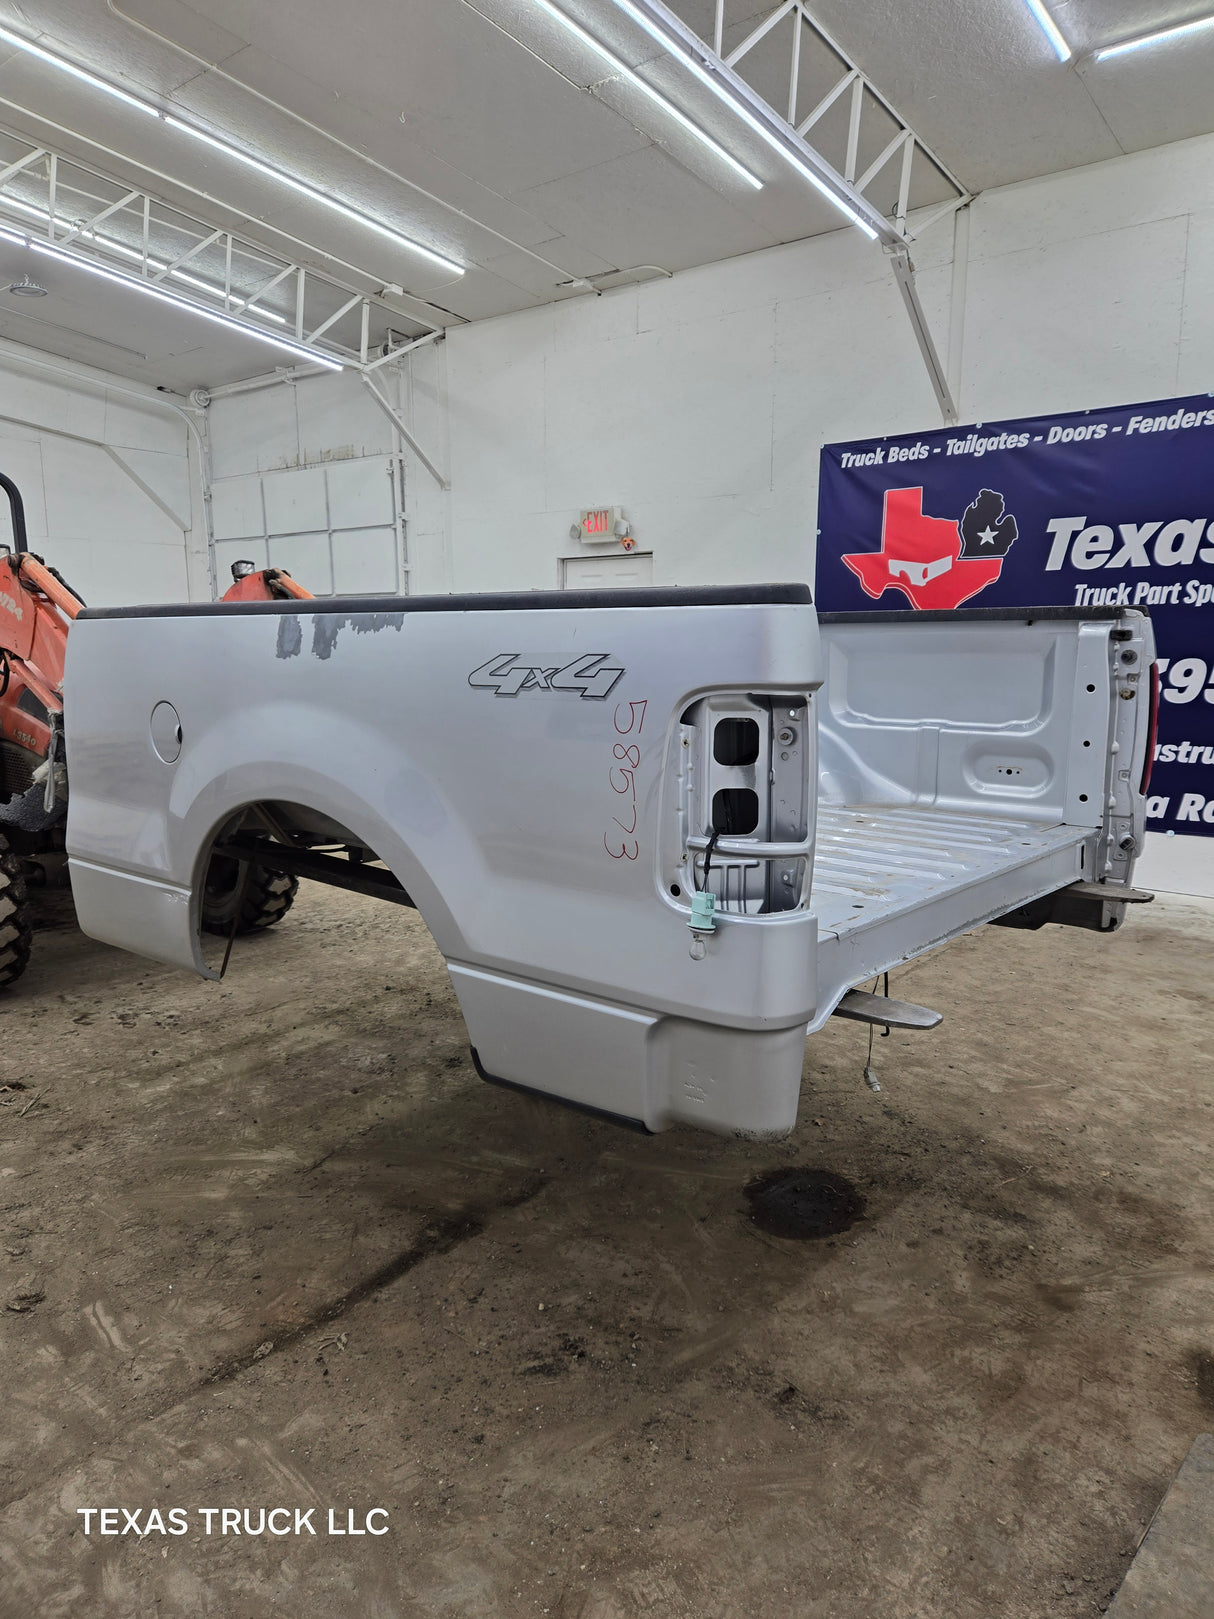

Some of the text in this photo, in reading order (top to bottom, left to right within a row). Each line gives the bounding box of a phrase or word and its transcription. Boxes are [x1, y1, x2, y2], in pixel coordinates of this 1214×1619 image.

[841, 448, 885, 468] Truck
[888, 442, 930, 463] Beds
[946, 433, 1030, 457] Tailgates
[1046, 424, 1108, 445] Doors
[1126, 409, 1214, 435] Fenders
[586, 510, 609, 533] EXIT
[1075, 579, 1214, 607] Truck Part Sp
[468, 653, 626, 700] 4x4
